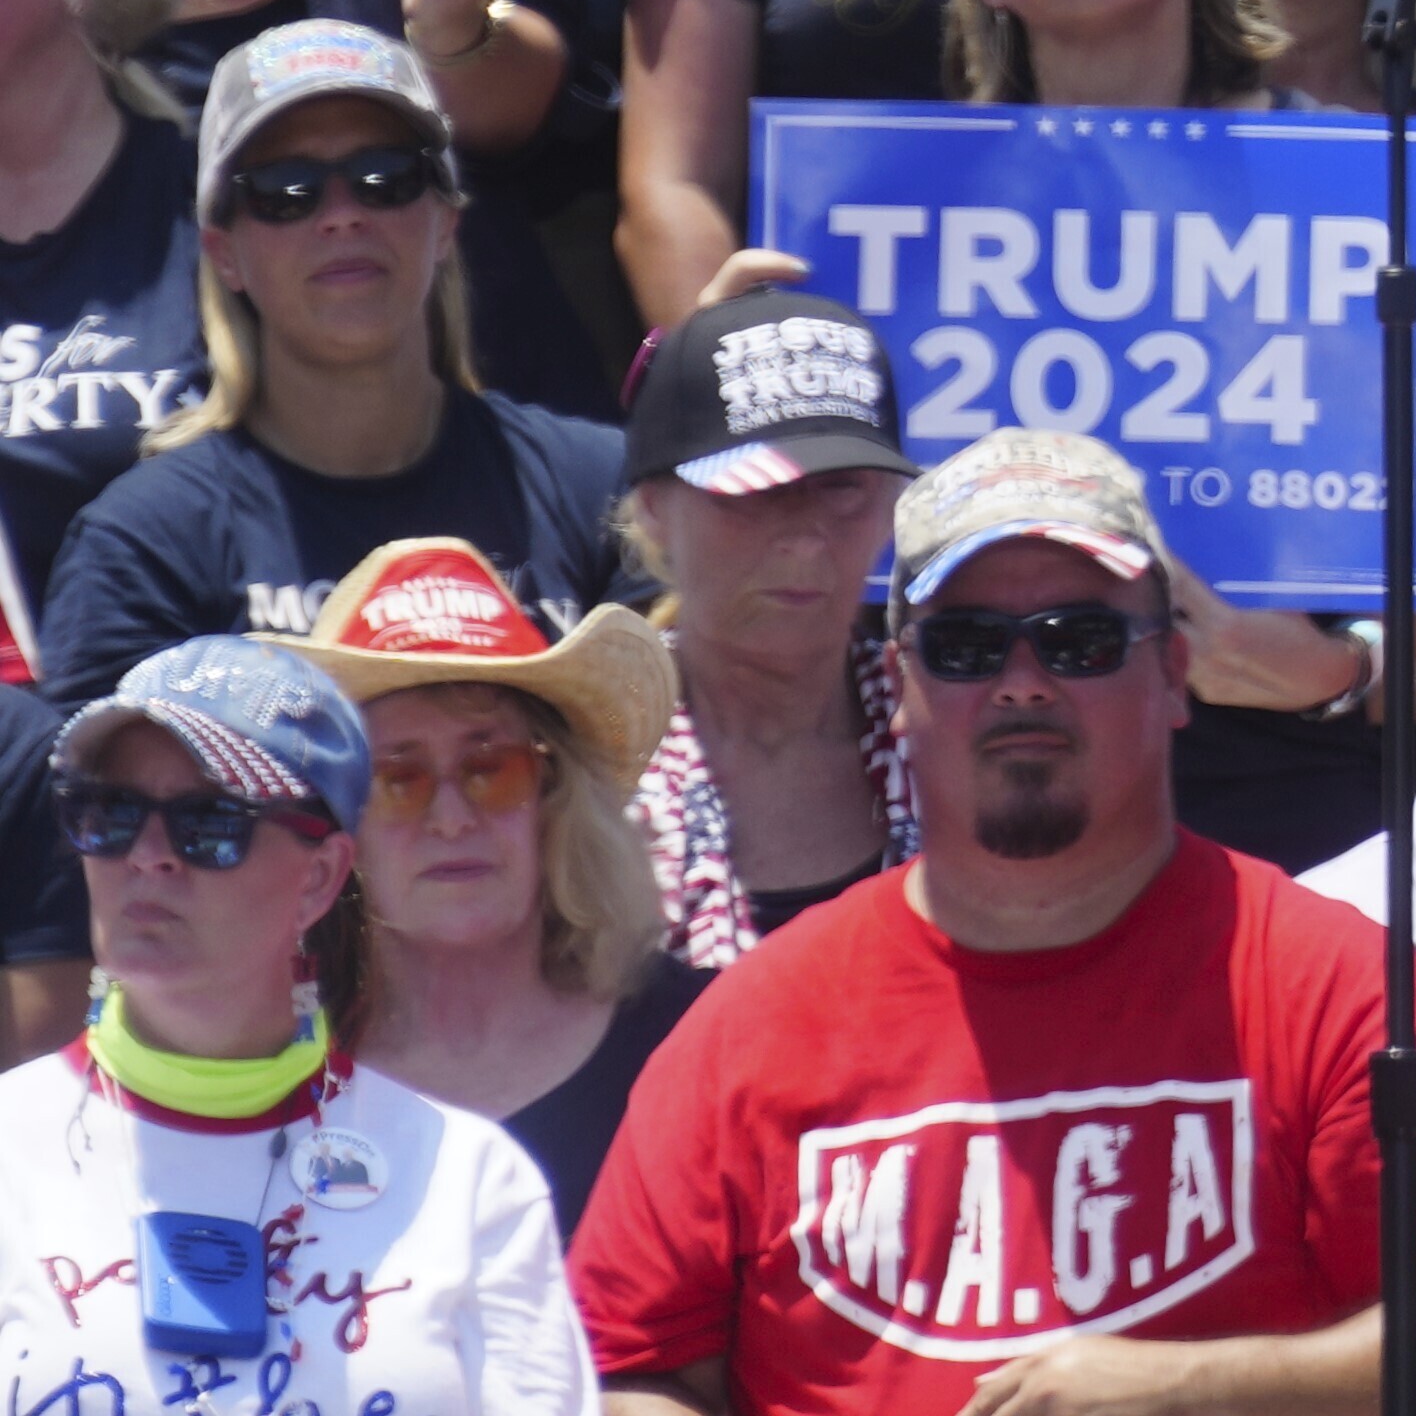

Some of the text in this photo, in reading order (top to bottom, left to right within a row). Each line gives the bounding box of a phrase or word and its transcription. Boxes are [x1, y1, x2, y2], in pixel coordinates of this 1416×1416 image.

[829, 204, 1394, 327] TRUMP
[906, 326, 1320, 447] 2024
[1164, 465, 1232, 507] TO
[360, 588, 506, 632] TRUMP
